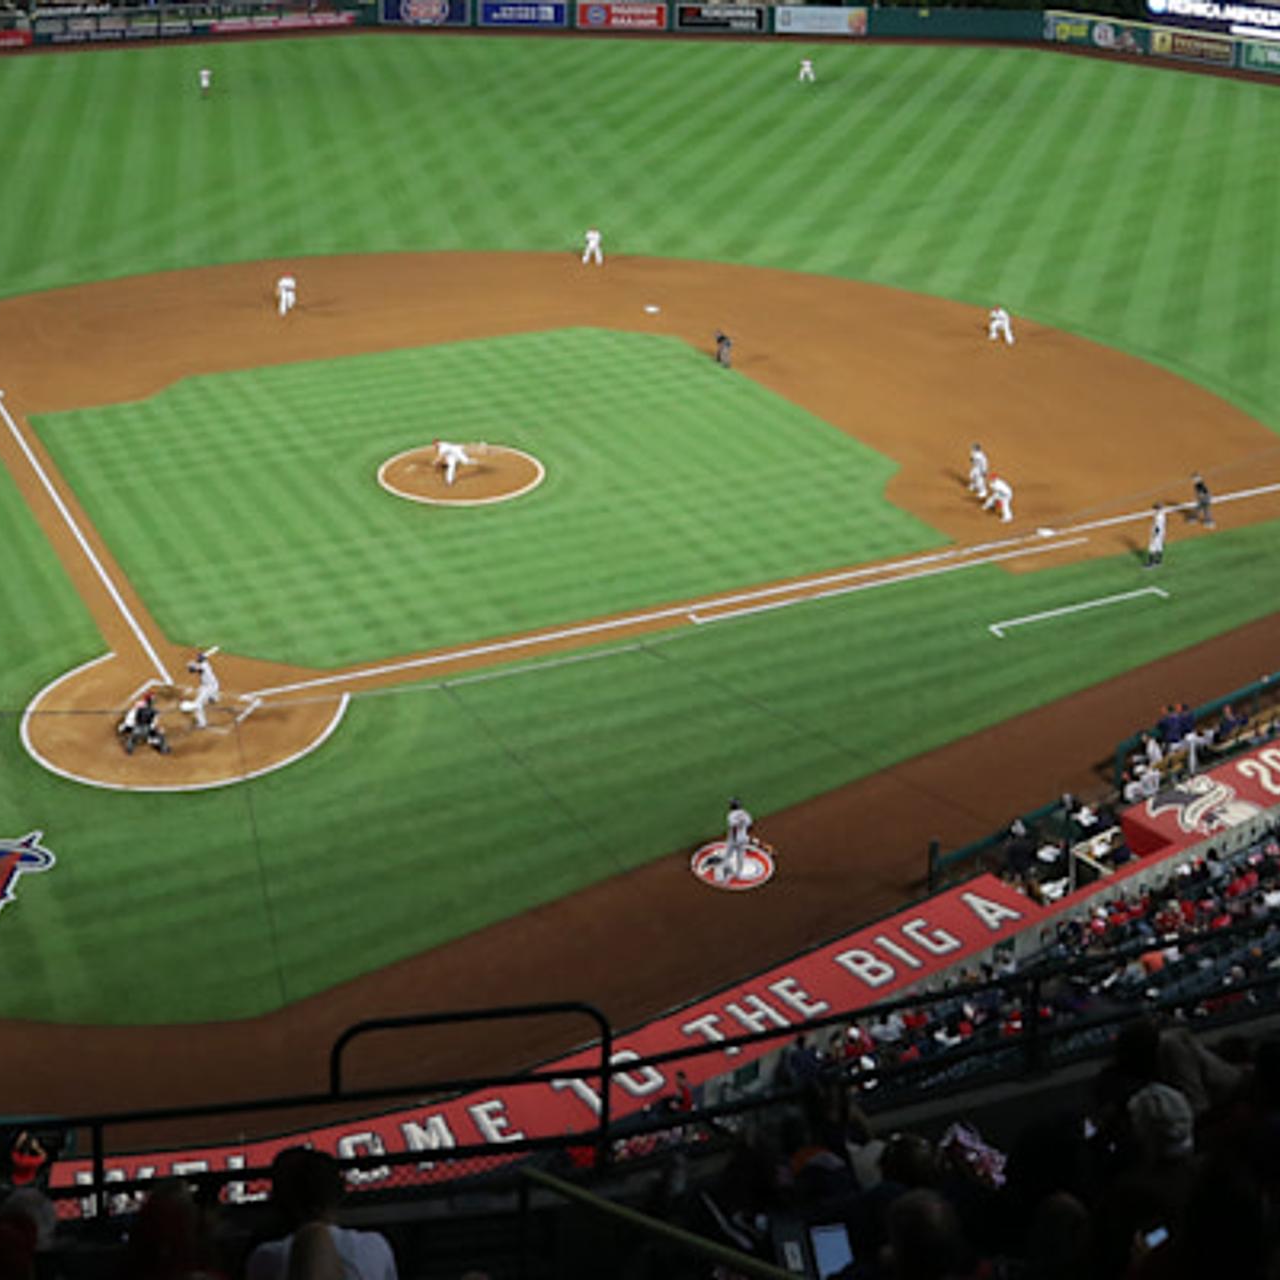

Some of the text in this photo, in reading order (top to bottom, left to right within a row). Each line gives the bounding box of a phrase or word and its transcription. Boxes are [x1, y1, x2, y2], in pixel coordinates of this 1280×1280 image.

[681, 976, 830, 1056] THE
[834, 918, 962, 989] BIG
[960, 891, 1022, 931] A
